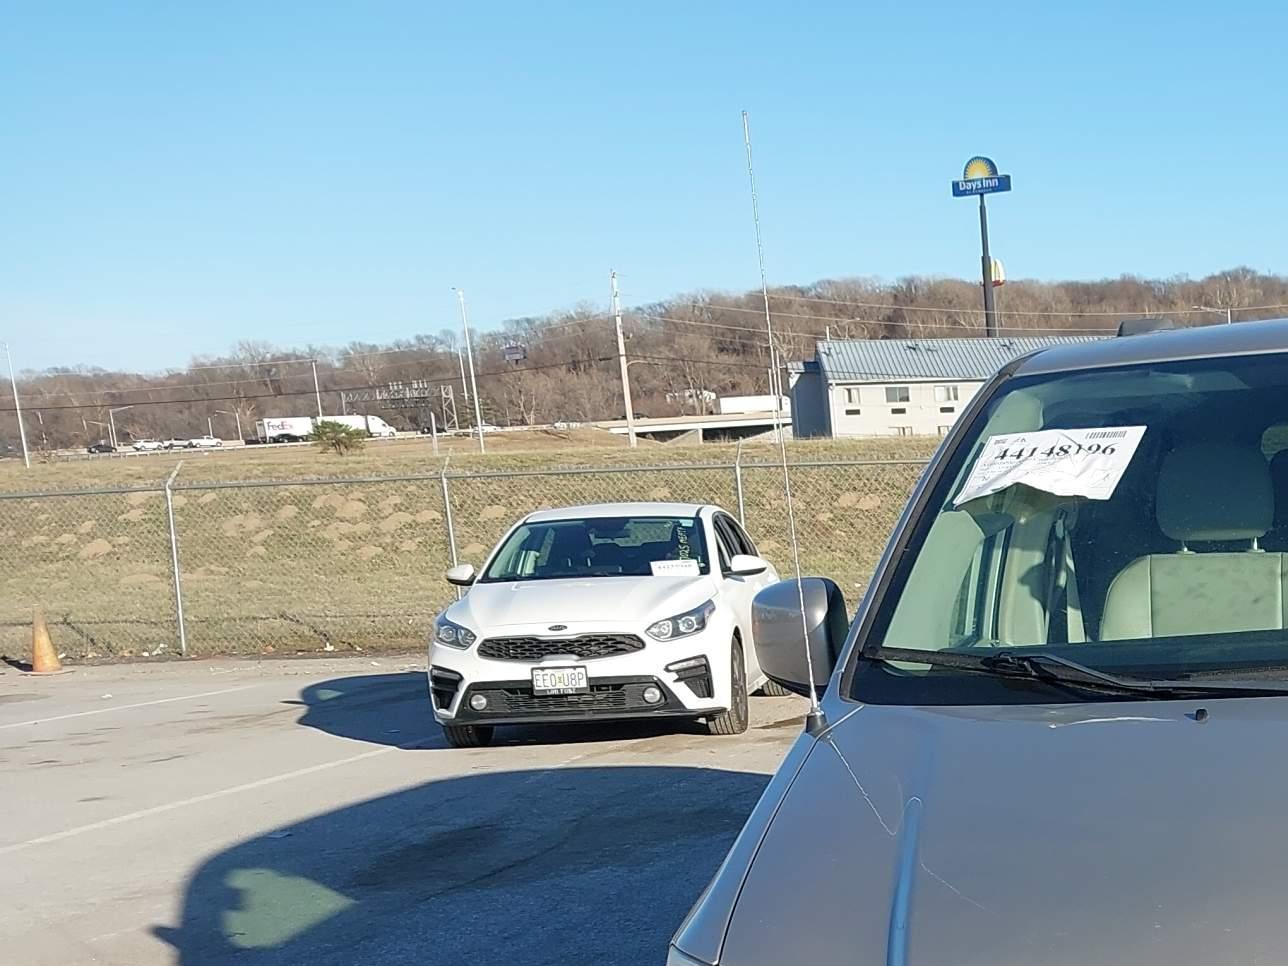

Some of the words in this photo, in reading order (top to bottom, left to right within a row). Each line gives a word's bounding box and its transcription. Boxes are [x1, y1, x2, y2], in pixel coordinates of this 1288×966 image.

[959, 179, 982, 191] Days
[983, 178, 999, 188] Inn
[994, 442, 1120, 460] 44148196
